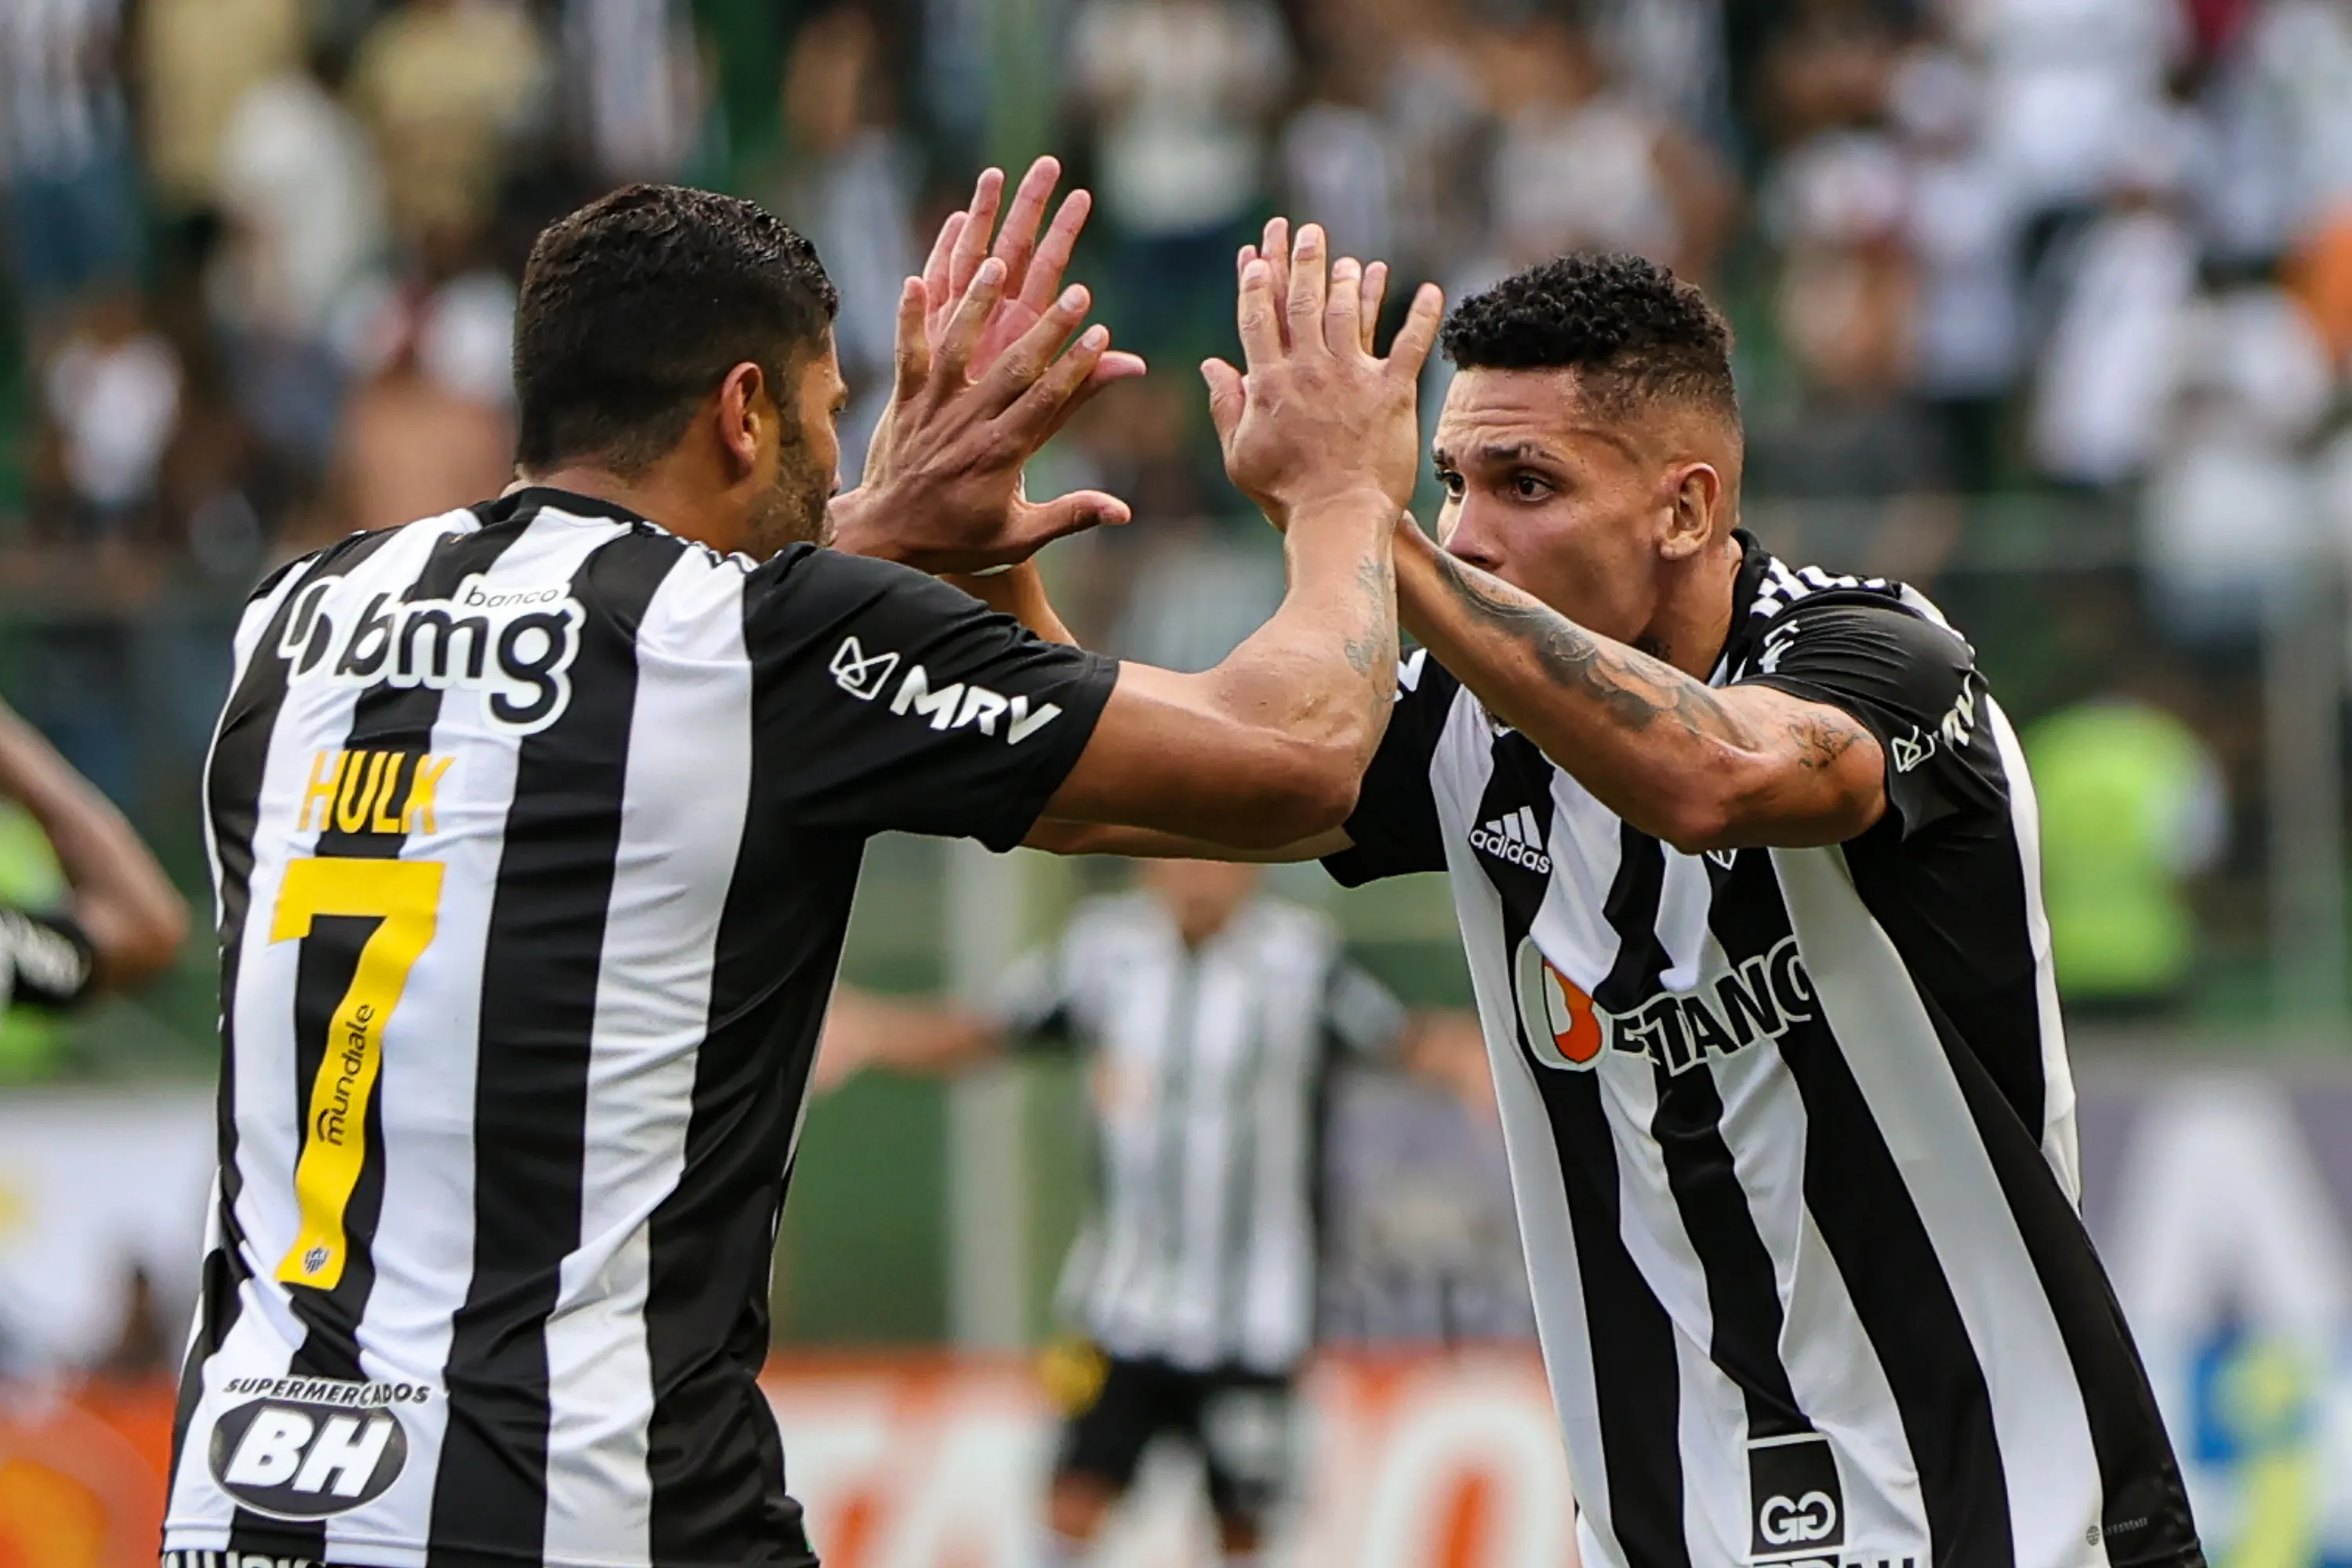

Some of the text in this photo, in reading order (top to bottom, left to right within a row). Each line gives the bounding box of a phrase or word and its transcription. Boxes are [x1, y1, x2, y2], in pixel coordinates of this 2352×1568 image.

[464, 584, 559, 608] banco
[335, 593, 573, 724] bmg
[890, 664, 1063, 746] MRV
[297, 750, 456, 834] HULK
[1470, 829, 1552, 874] adidas
[269, 858, 447, 1291] 7
[317, 1004, 375, 1146] mundiale
[223, 1377, 432, 1405] SUPERMERCADOS
[224, 1406, 394, 1497] BH
